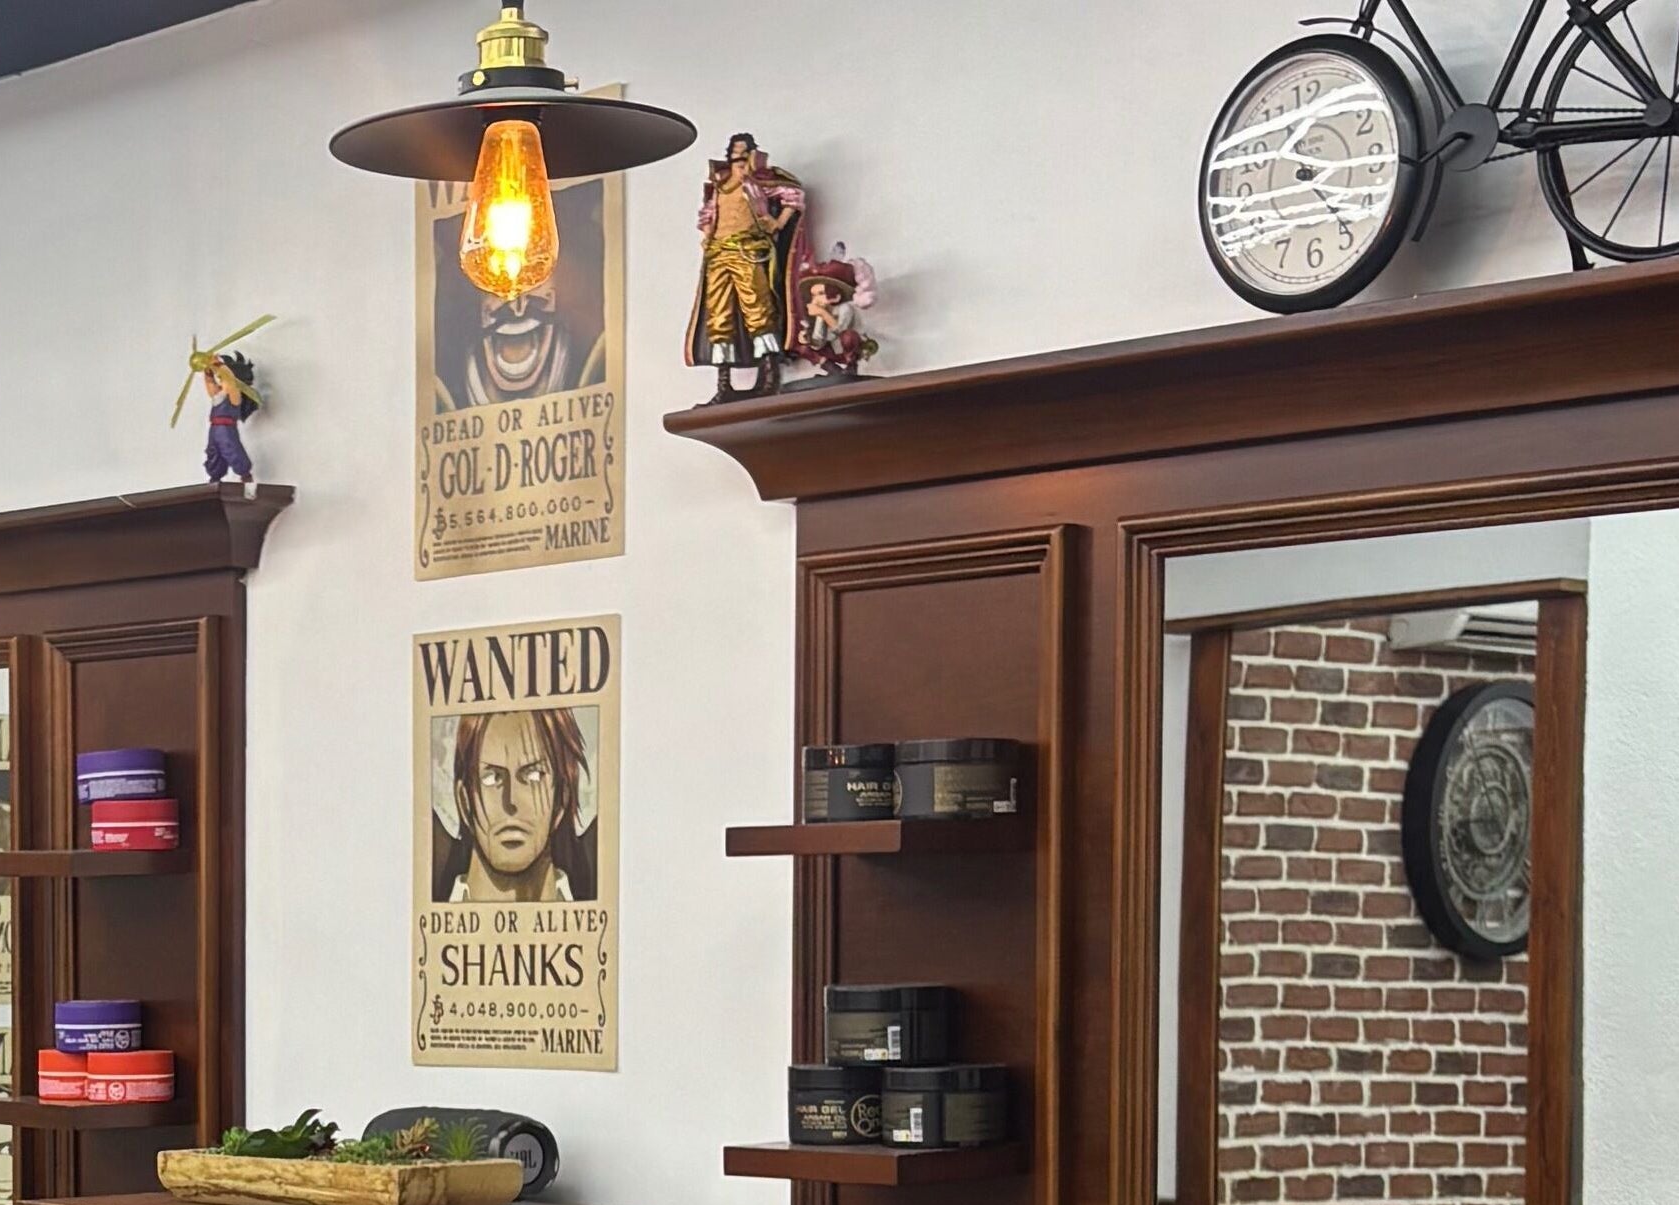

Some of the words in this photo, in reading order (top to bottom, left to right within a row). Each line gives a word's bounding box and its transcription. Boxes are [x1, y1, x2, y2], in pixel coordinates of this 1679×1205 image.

[1356, 110, 1375, 136] 2
[1339, 220, 1354, 250] 5
[1275, 238, 1292, 269] 7
[1306, 237, 1324, 268] 6
[433, 415, 484, 444] DEAD
[498, 408, 523, 433] OR
[538, 393, 605, 427] ALIVE
[545, 517, 611, 550] MARINE
[419, 626, 610, 706] WANTED
[847, 782, 878, 791] HAIR
[430, 912, 480, 934] DEAD
[494, 911, 519, 933] OR
[533, 910, 598, 933] ALIVE
[441, 944, 584, 987] SHANKS
[541, 1027, 603, 1055] MARINE
